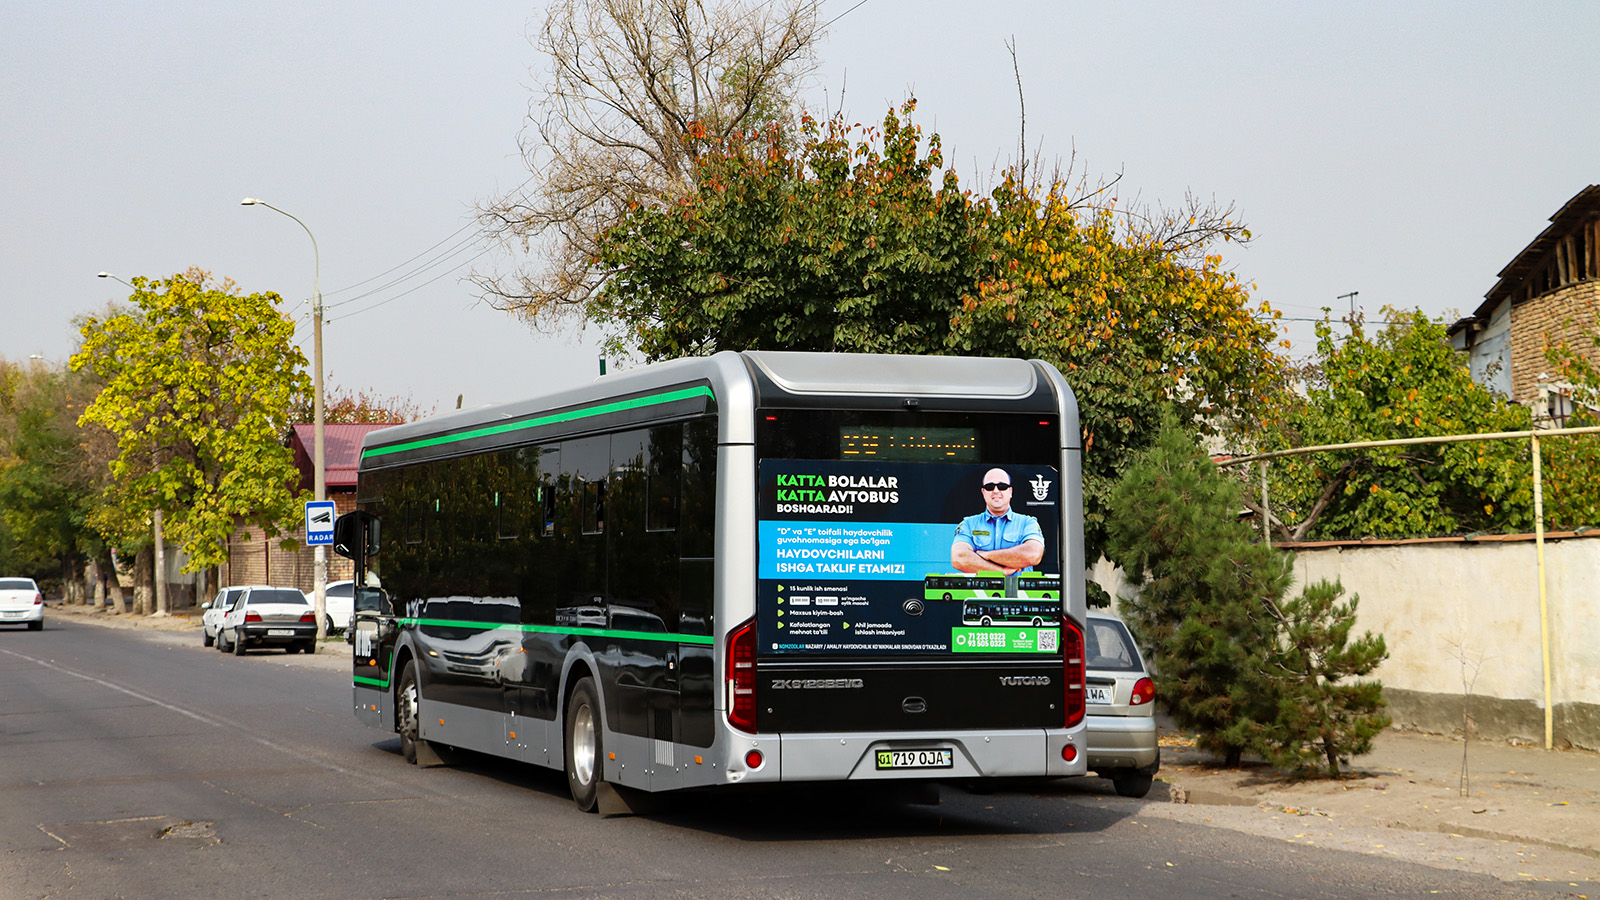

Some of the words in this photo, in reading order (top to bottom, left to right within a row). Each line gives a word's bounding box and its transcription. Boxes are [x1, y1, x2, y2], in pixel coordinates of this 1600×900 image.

[777, 474, 826, 487] KATTA
[828, 475, 898, 489] BOLALAR
[777, 489, 826, 502] KATTA
[828, 490, 899, 504] AVTOBUS
[776, 503, 853, 514] BOSHQARADI!
[818, 528, 842, 537] toifali
[843, 528, 893, 538] haydovchilik
[777, 537, 842, 546] guvohnomasiga
[844, 538, 860, 546] ega
[777, 549, 884, 560] HAYDOVCHILARNI
[777, 563, 813, 573] ISHGA
[816, 563, 856, 574] TAKLIF
[859, 564, 905, 574] ETAMIZ!
[999, 676, 1051, 686] YUTONG
[880, 754, 891, 764] 01
[894, 752, 915, 765] 719
